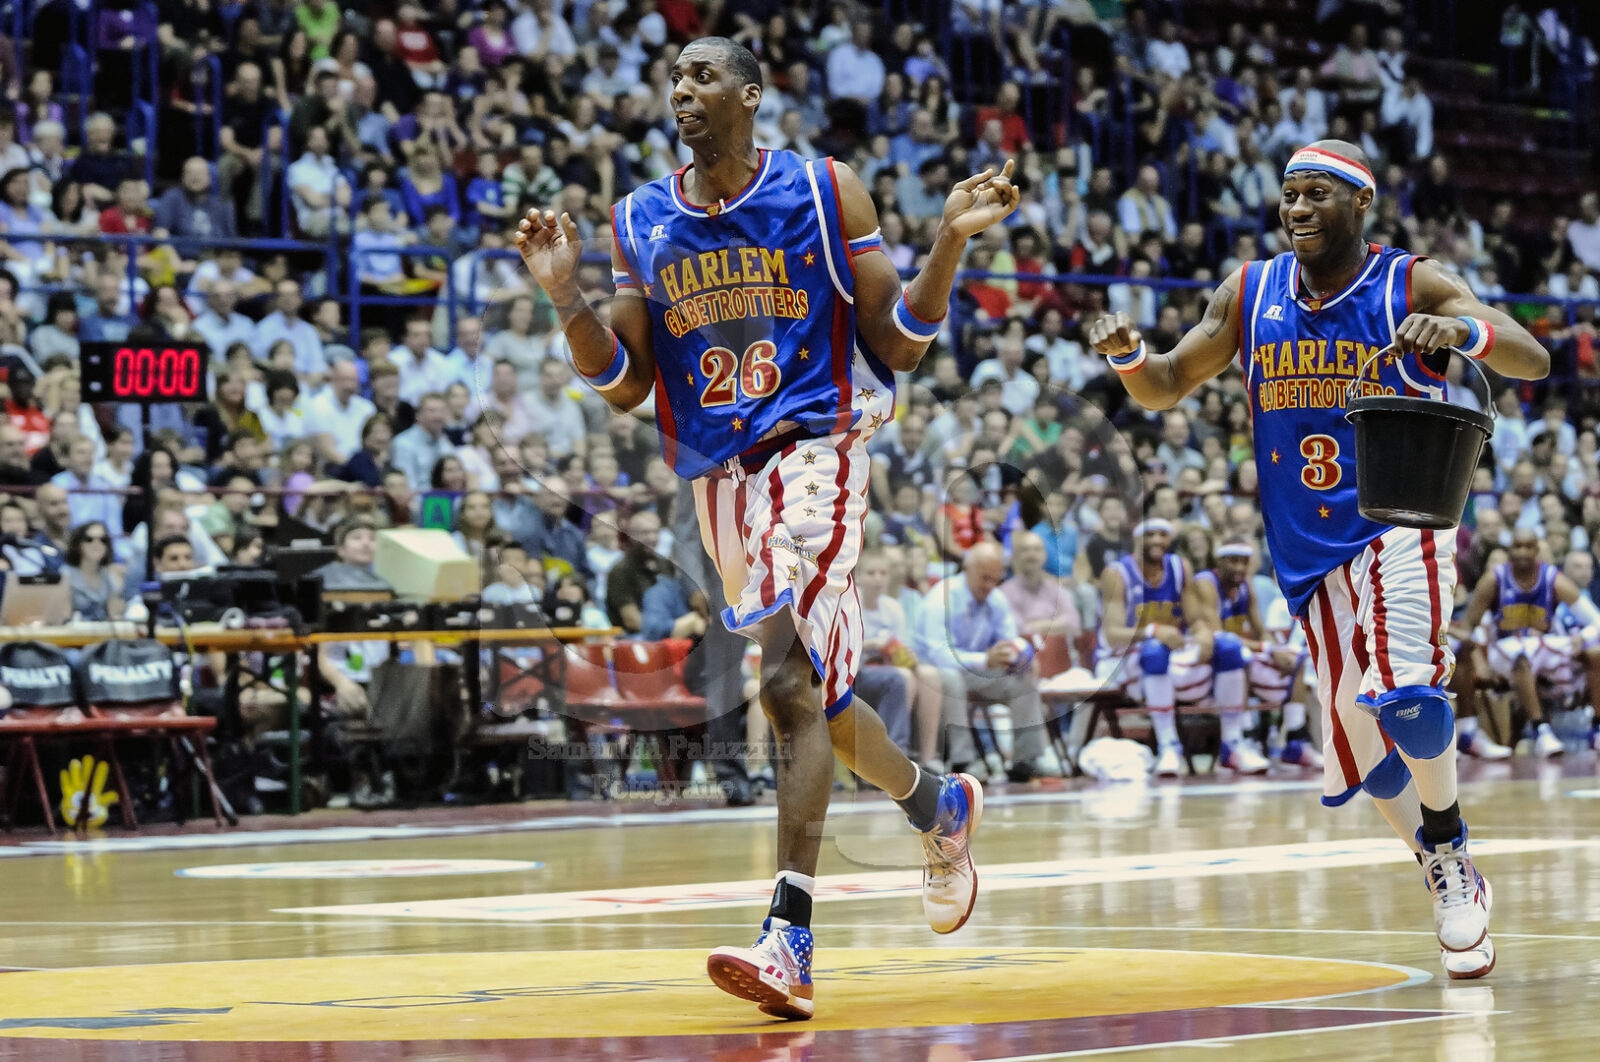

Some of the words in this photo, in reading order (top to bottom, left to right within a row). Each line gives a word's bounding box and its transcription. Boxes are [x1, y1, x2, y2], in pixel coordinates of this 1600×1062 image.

[660, 247, 789, 303] HARLEM
[113, 348, 199, 396] 00:00
[700, 340, 782, 407] 26
[1260, 340, 1380, 380] HARLEM
[1300, 434, 1342, 490] 3
[88, 659, 173, 684] PENALTY
[244, 951, 1082, 1009] betair
